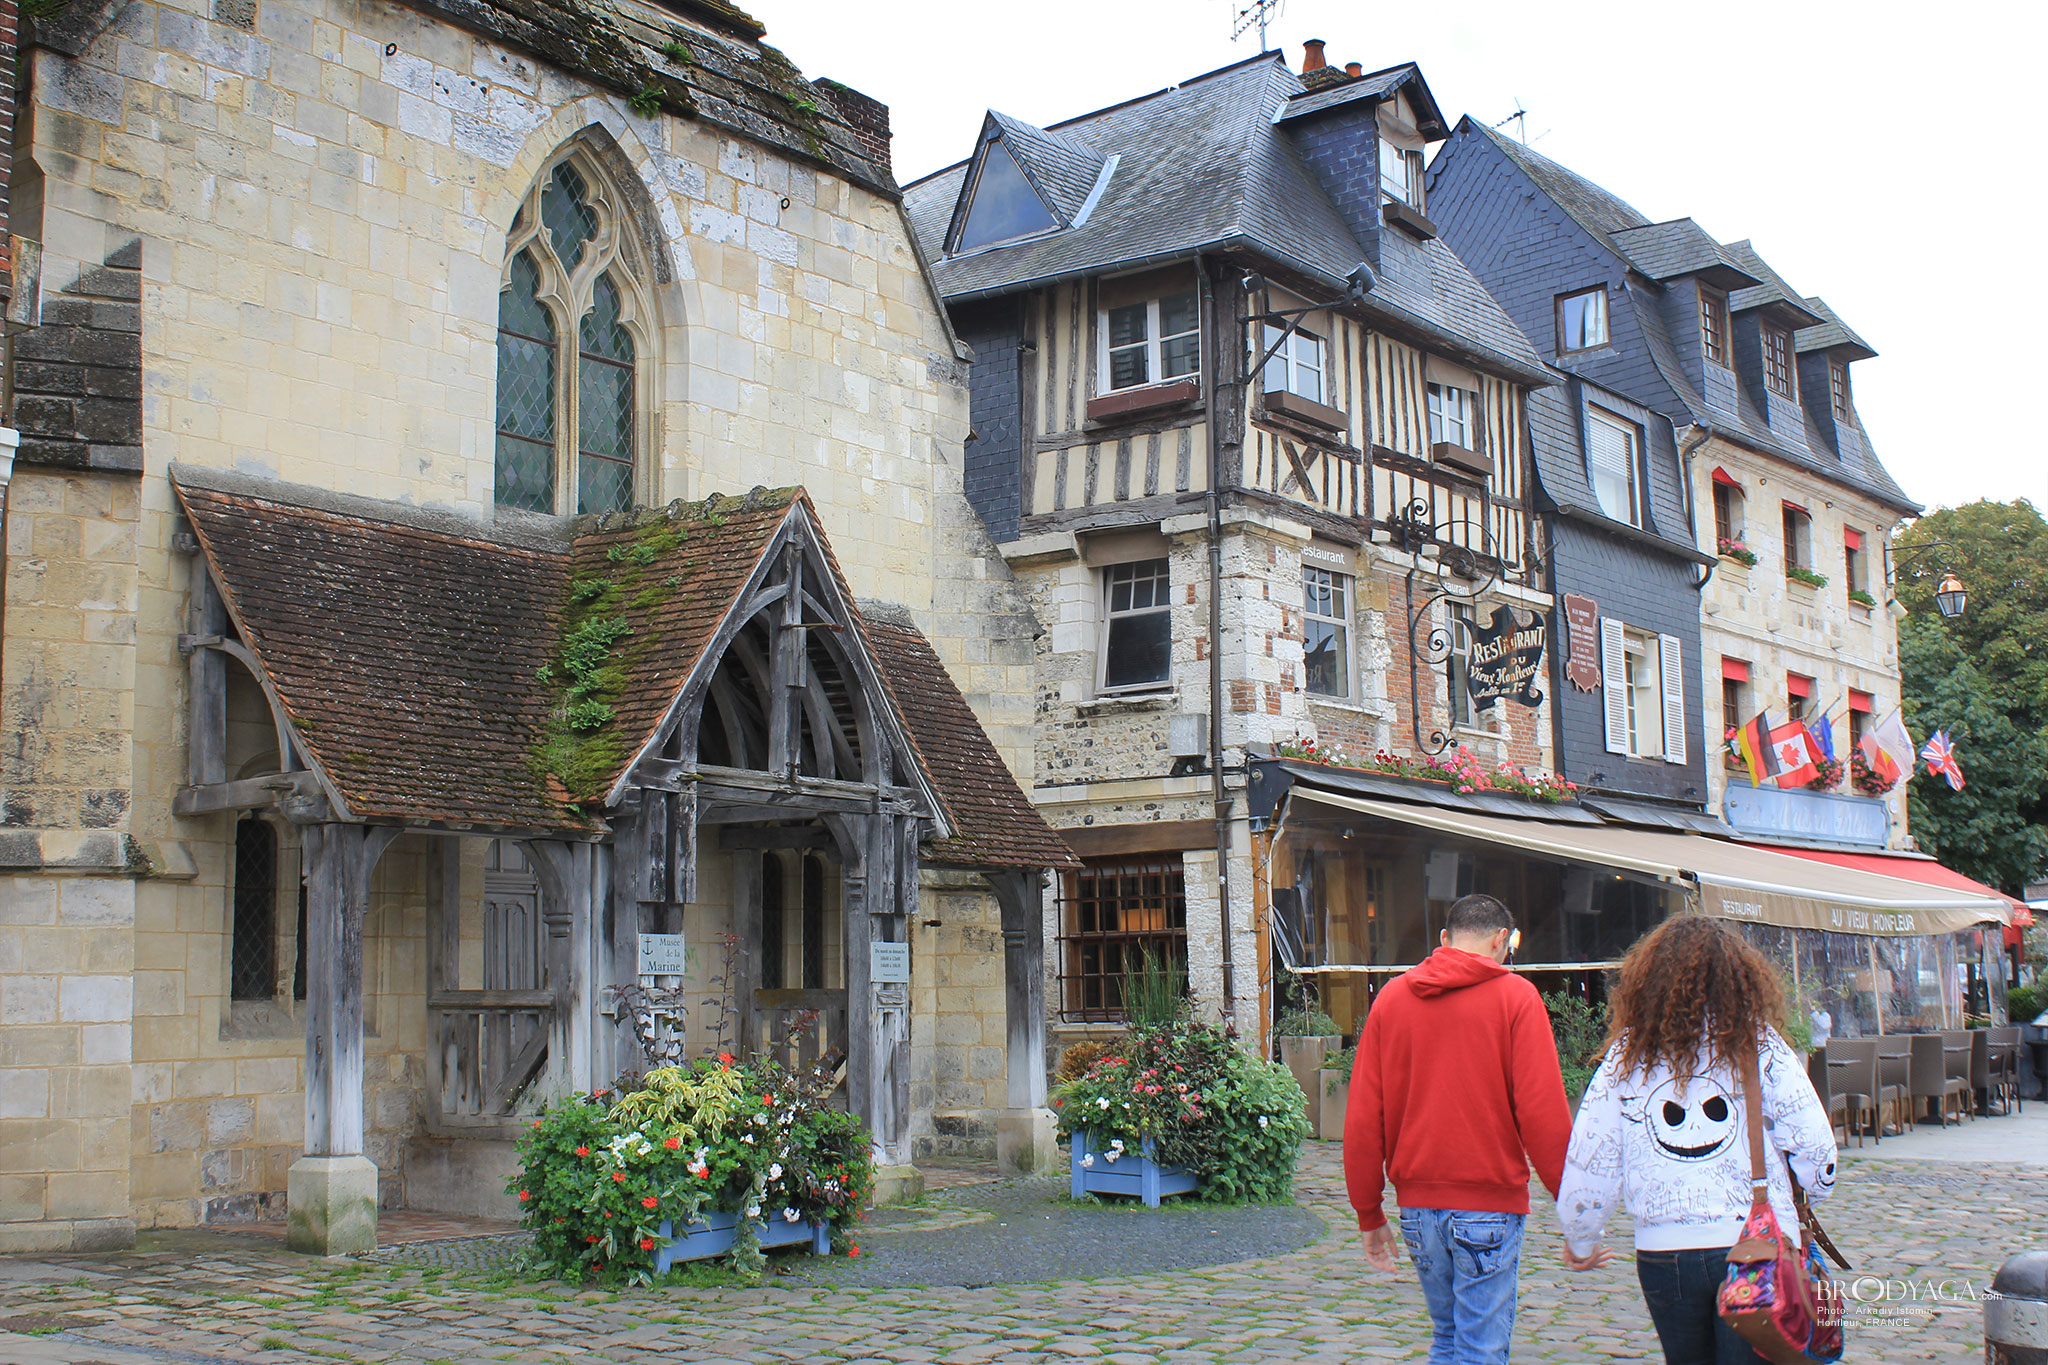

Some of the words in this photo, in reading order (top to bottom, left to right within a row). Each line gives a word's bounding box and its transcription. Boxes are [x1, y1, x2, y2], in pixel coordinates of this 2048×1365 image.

[1473, 626, 1545, 664] RESTAURANT
[1511, 656, 1527, 665] DU
[1469, 665, 1496, 686] Vieux
[1722, 899, 1763, 918] RESTAURANT
[1832, 908, 1843, 928] AU
[1846, 909, 1870, 930] VIEUX
[1872, 913, 1916, 932] HONFLEUR
[665, 949, 673, 958] de
[674, 949, 681, 958] la
[647, 960, 681, 972] Marine
